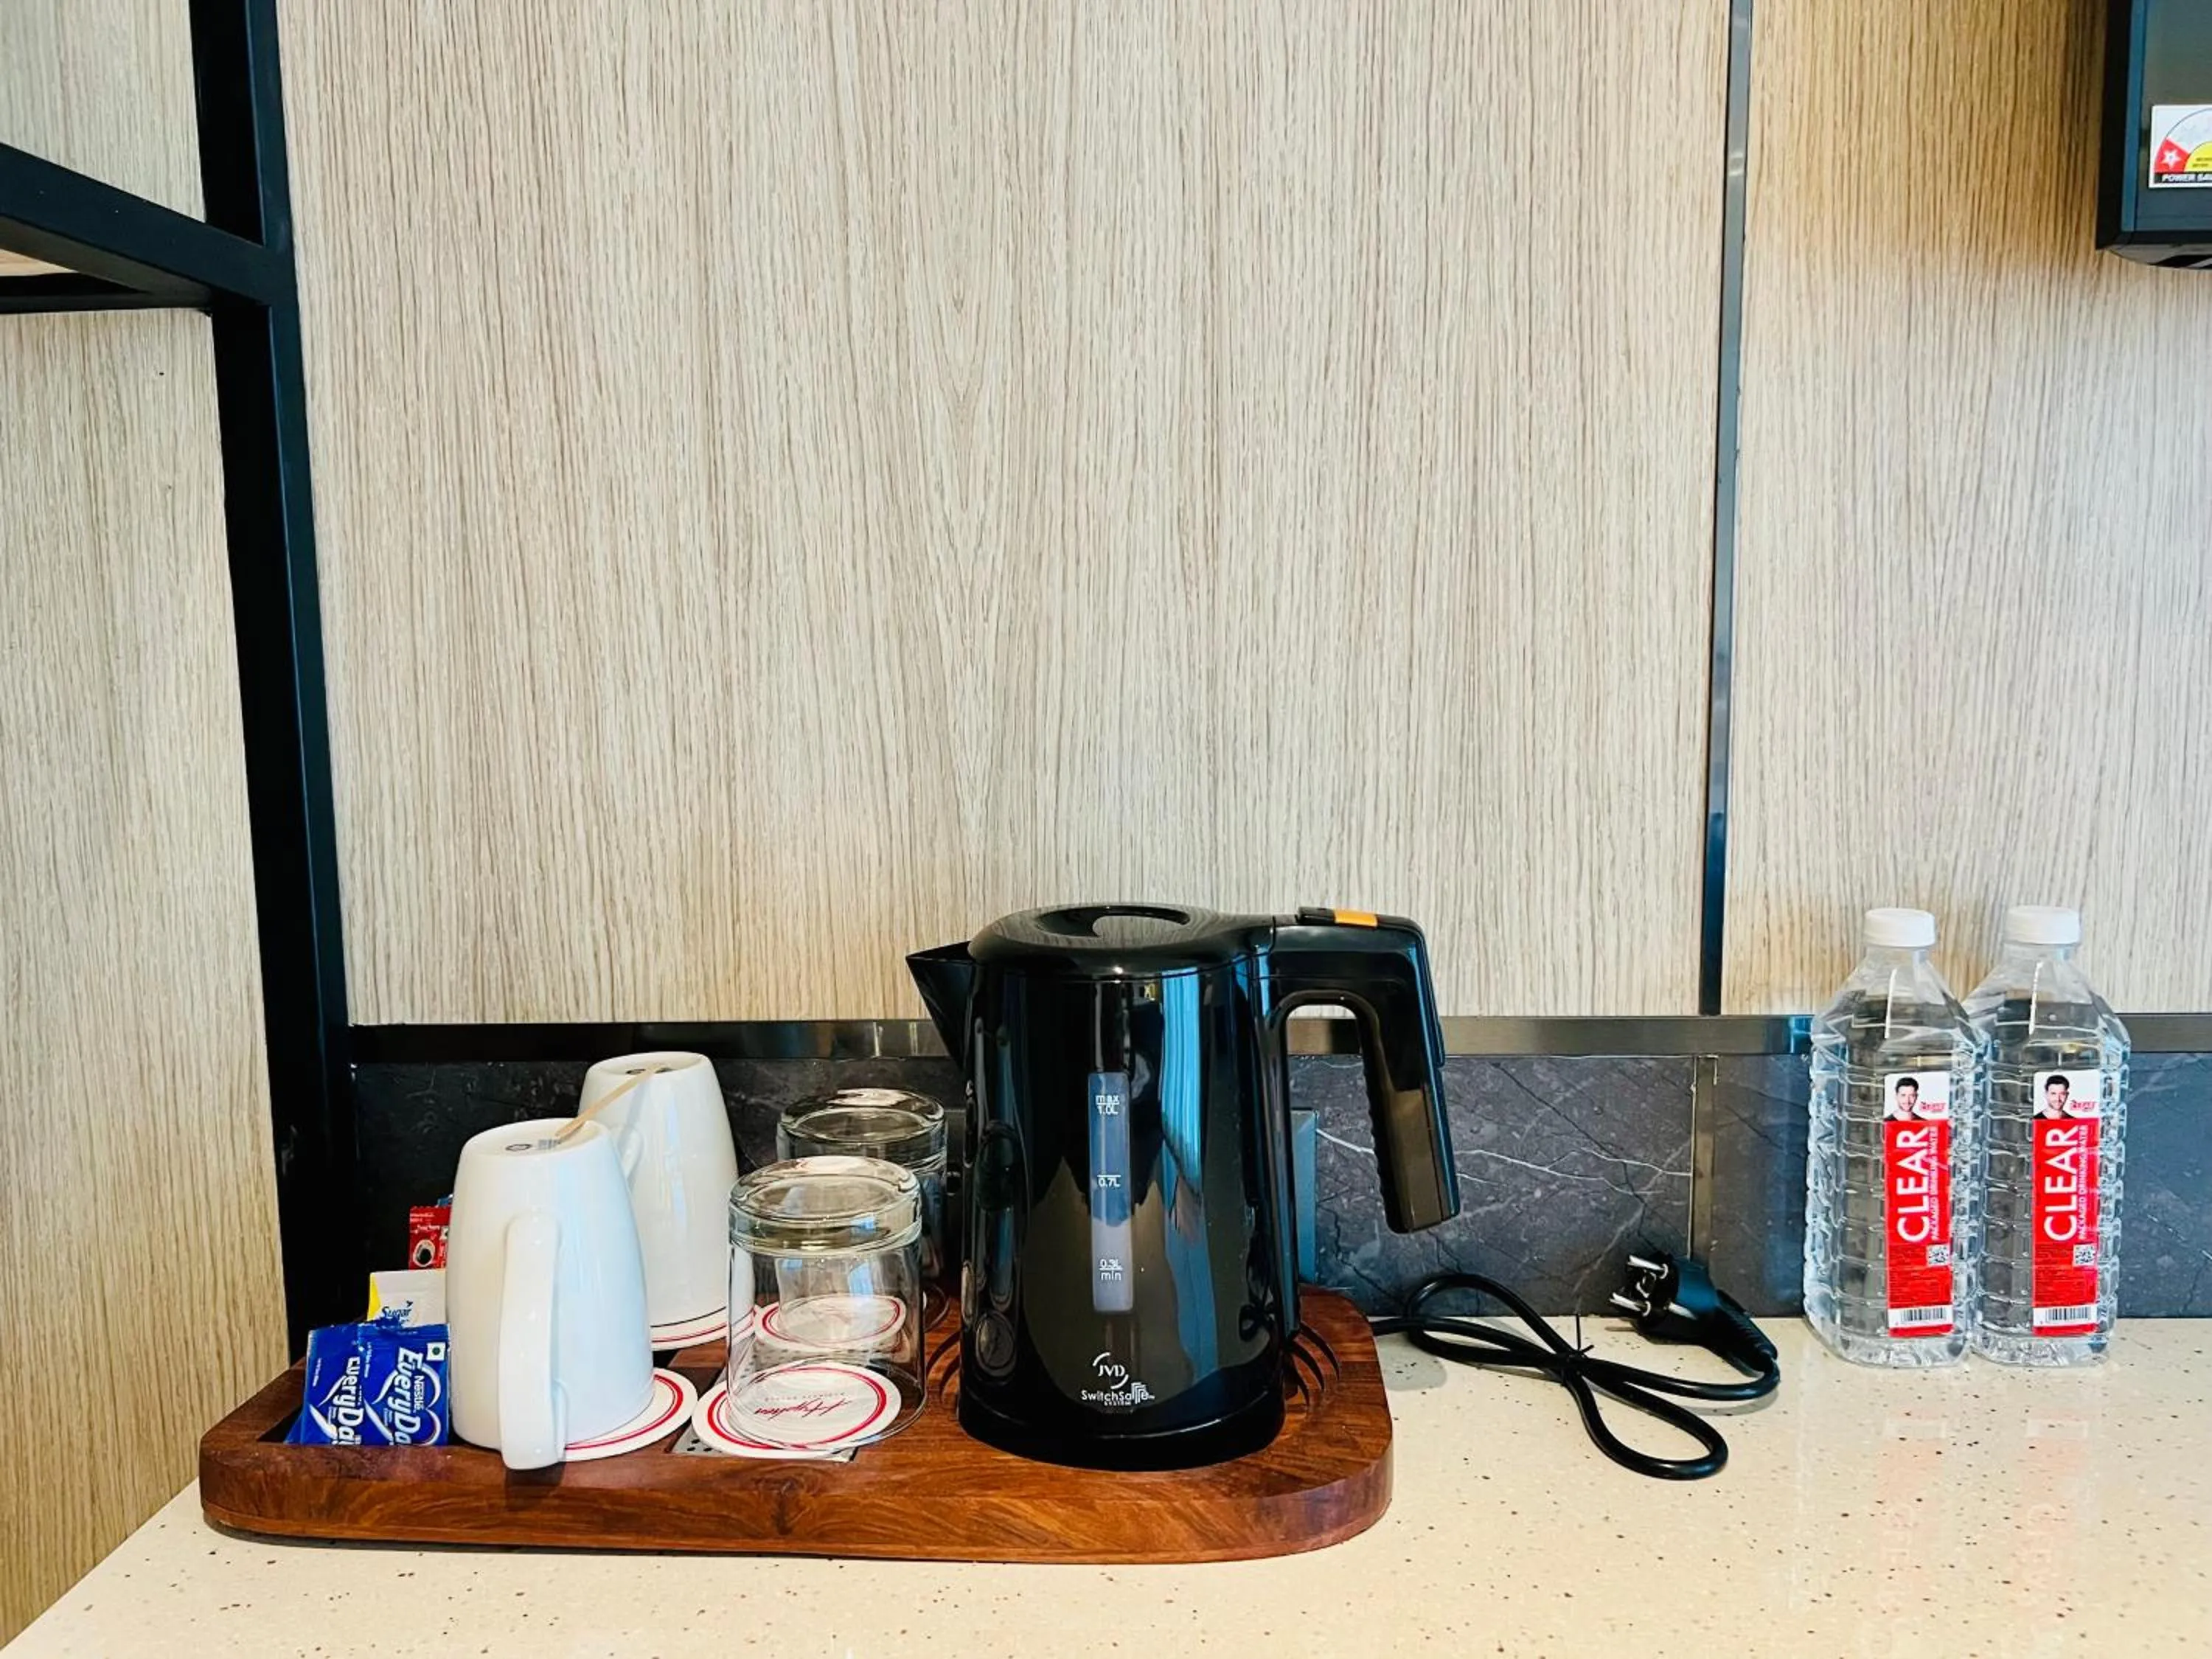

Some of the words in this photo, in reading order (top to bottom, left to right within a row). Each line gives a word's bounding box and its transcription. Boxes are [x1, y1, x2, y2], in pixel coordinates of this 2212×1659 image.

[1096, 1095, 1119, 1105] max
[1098, 1177, 1121, 1188] 0.7L
[1896, 1125, 1930, 1243] CLEAR
[2043, 1124, 2079, 1242] CLEAR
[2079, 1196, 2087, 1239] PACKAGED
[1101, 1270, 1121, 1281] min
[1098, 1364, 1126, 1377] JVD
[388, 1346, 423, 1445] EveryDa
